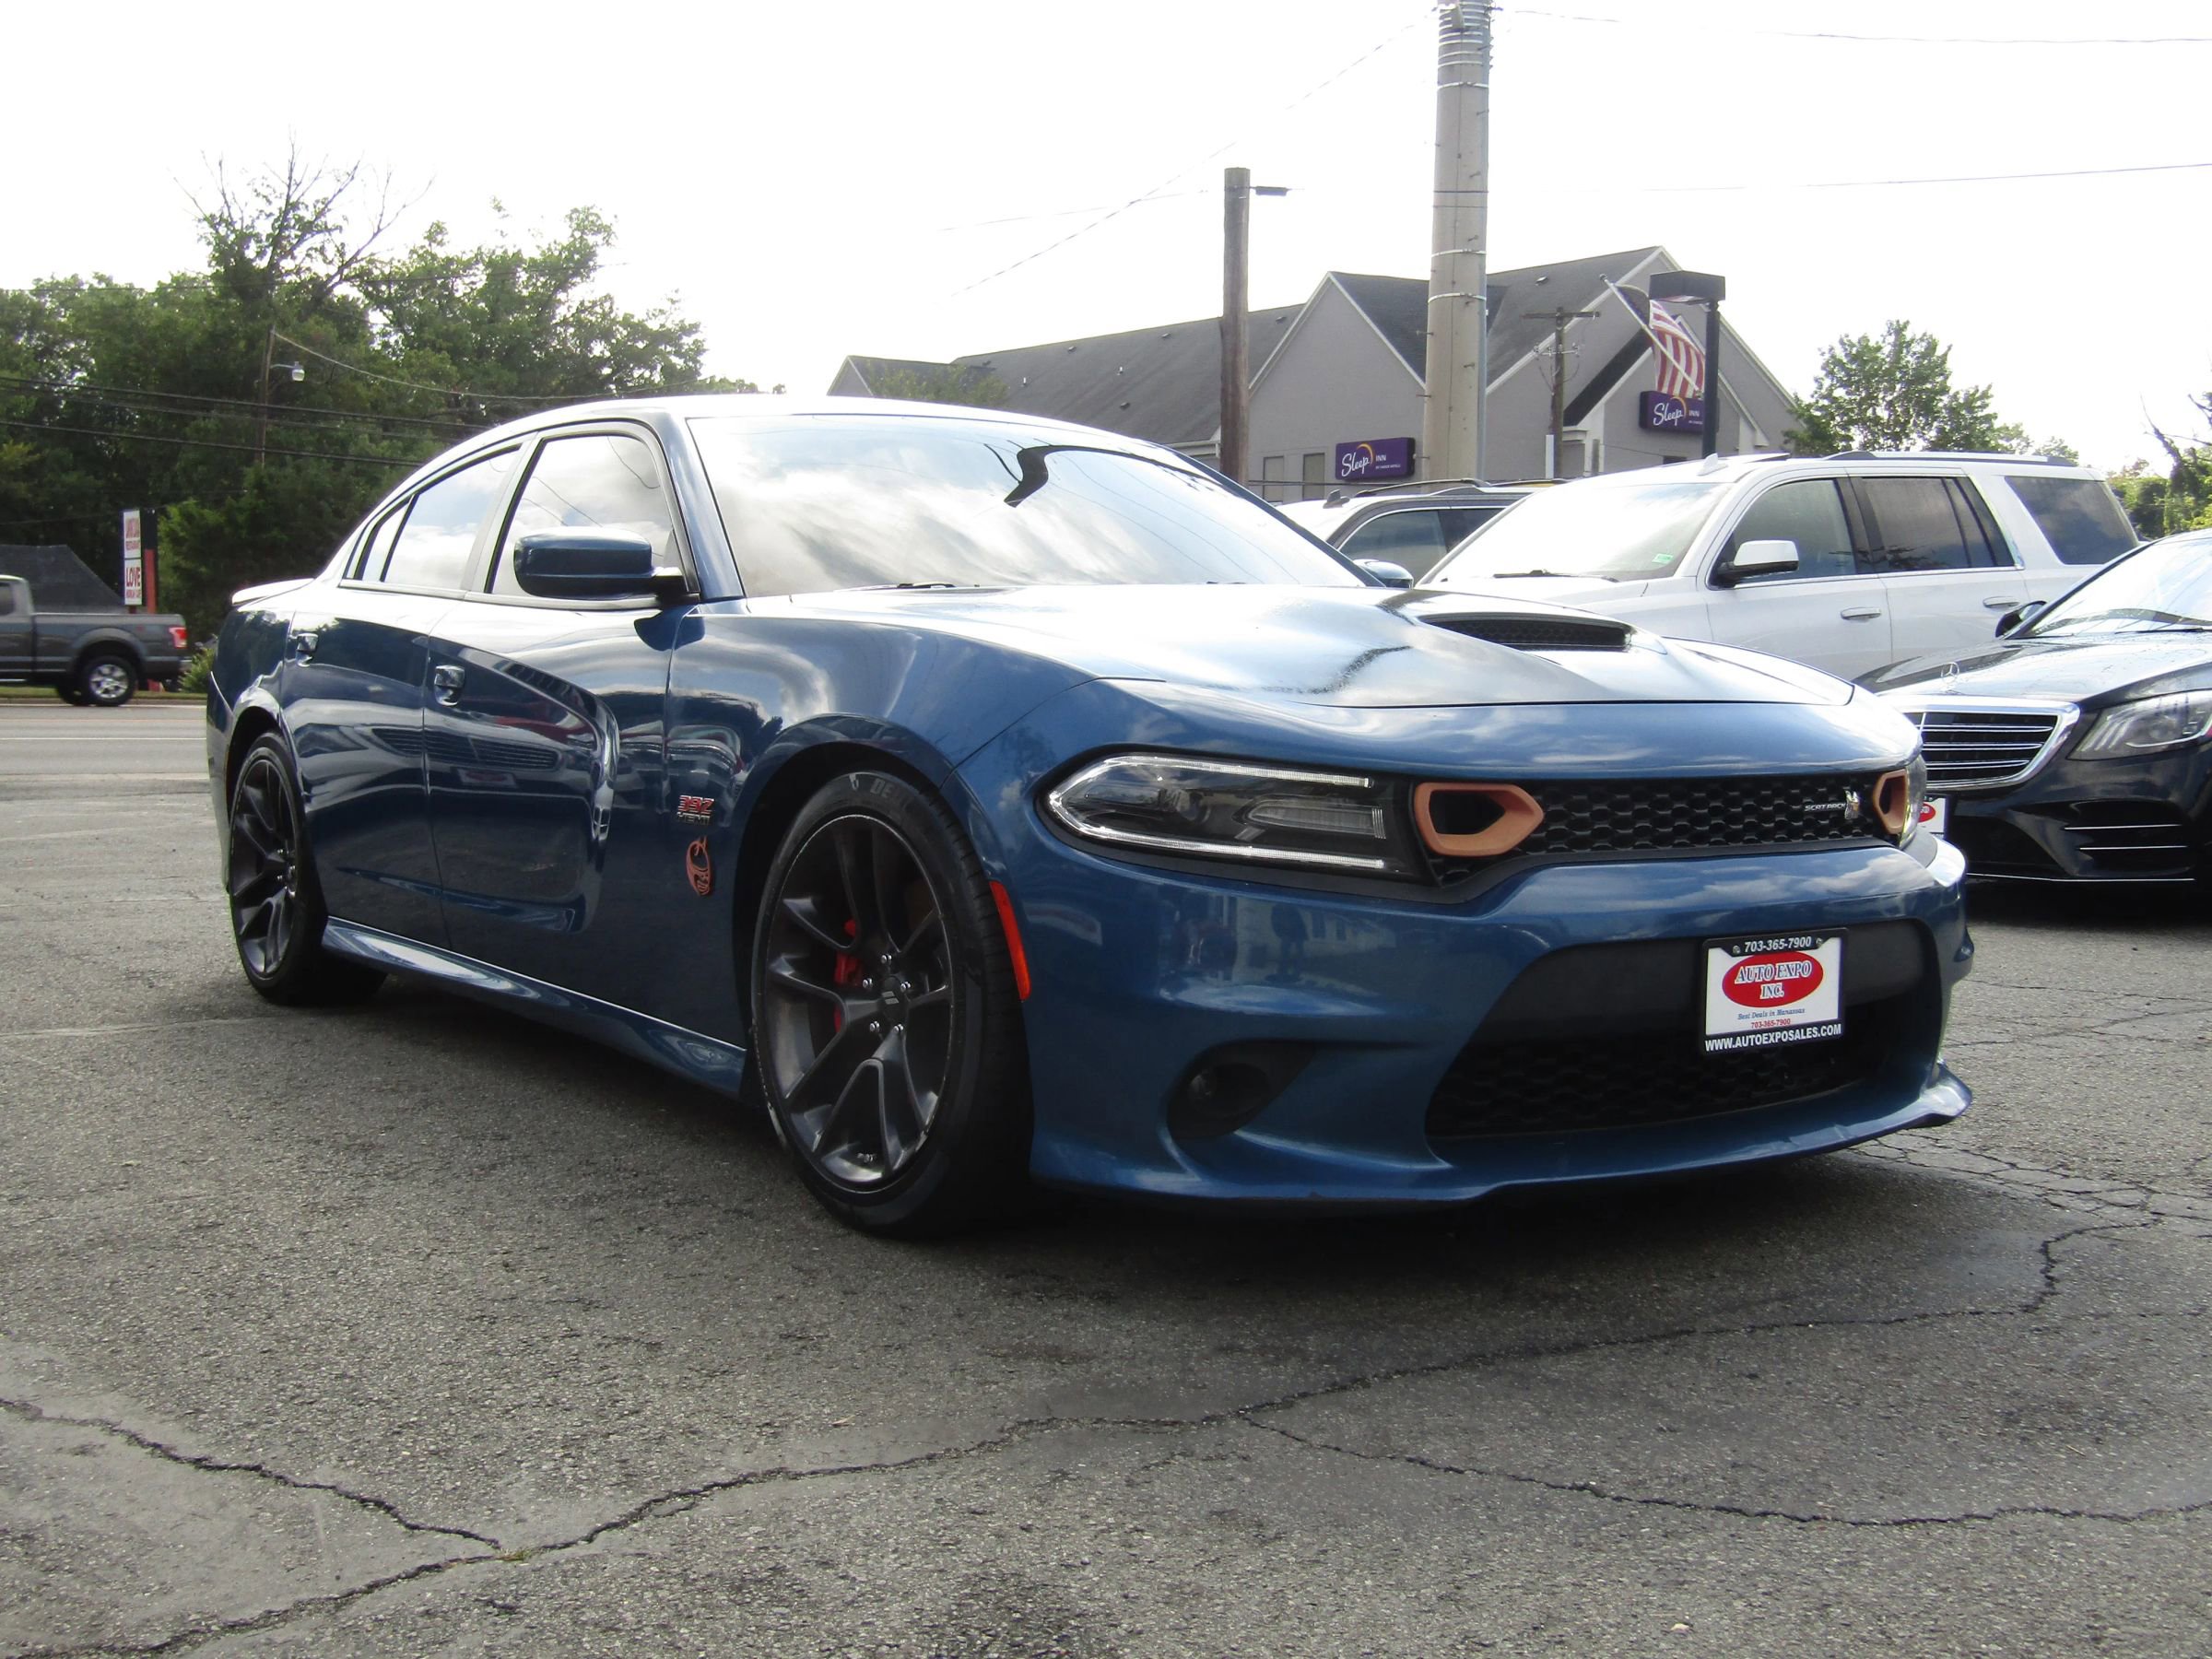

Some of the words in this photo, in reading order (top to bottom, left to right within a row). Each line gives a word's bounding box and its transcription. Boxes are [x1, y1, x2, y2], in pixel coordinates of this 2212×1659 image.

[1653, 402, 1684, 427] Sleep
[1341, 452, 1370, 477] Sleep
[126, 566, 141, 587] LOVE
[677, 794, 714, 814] 392
[677, 812, 711, 825] HEMI
[1744, 936, 1812, 952] 703-365-7900
[1735, 964, 1775, 983] AUTO
[1775, 960, 1812, 979] EXPO
[1760, 982, 1784, 999] INC.
[1751, 1010, 1768, 1018] Deals
[1777, 1007, 1806, 1016] Manassas
[1750, 1018, 1791, 1029] 703-365-7900
[1705, 1023, 1841, 1052] WWW.AUTOEXPOSALES.COM
